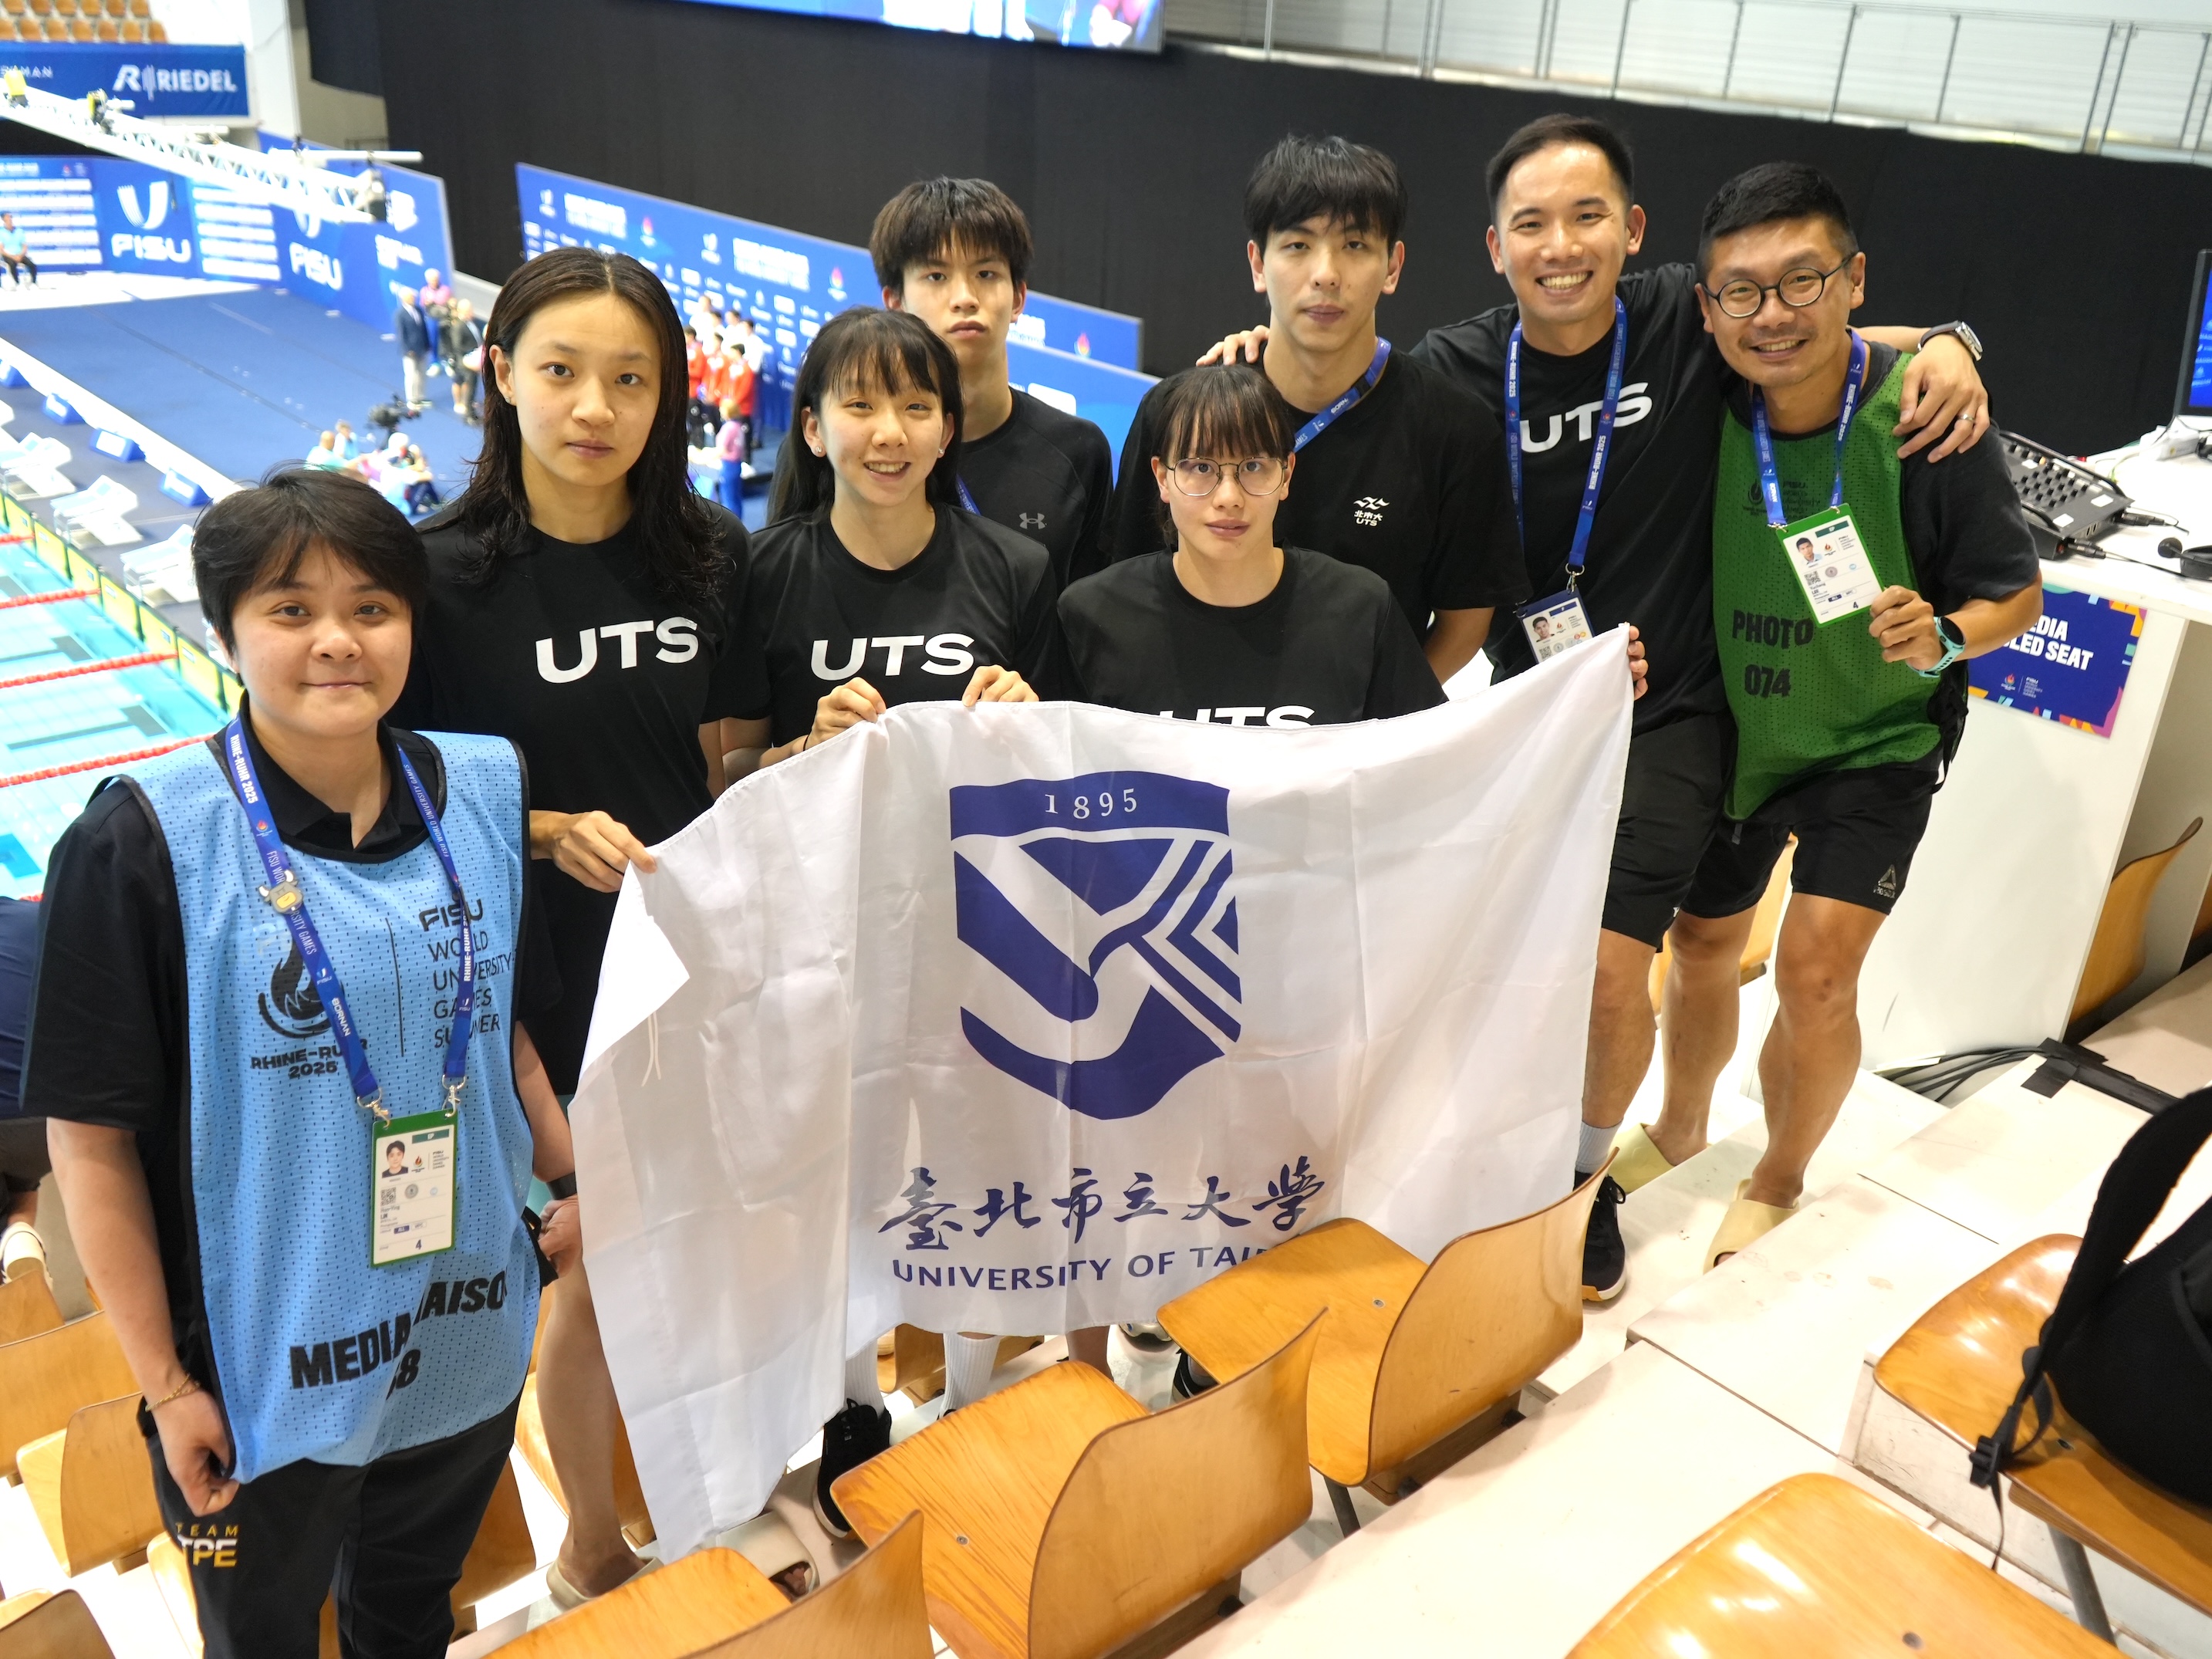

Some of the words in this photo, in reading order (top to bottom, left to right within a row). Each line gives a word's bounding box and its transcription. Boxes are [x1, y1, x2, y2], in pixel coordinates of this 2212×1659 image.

[157, 69, 237, 93] RIEDEL
[111, 233, 191, 263] FISU
[289, 242, 342, 290] FISU
[1520, 382, 1653, 453] UTS
[1354, 510, 1383, 521] 北市大
[1356, 518, 1377, 526] UTS
[1732, 609, 1814, 649] PHOTO
[535, 616, 699, 684] UTS
[811, 633, 974, 681] UTS
[2045, 640, 2094, 671] SEAT
[1744, 664, 1791, 699] 074
[230, 734, 251, 782] RHINE-RUHR
[241, 780, 258, 804] 2025
[404, 764, 417, 784] GAMES
[414, 785, 434, 819] UNIVERSITY
[1045, 788, 1138, 819] 1895
[429, 820, 444, 842] WORLD
[439, 843, 449, 857] FISU
[267, 850, 277, 867] FISU
[299, 931, 317, 956] GAMES
[419, 899, 483, 931] FISU
[427, 931, 488, 962] WOLD
[433, 952, 512, 991] UNERSITY
[332, 998, 351, 1036] BORNAN
[250, 1039, 368, 1069] RHINE-RUR
[288, 1060, 338, 1080] 2025
[415, 1238, 422, 1250] 4
[893, 1259, 1111, 1291] UNIVERSITY
[1128, 1251, 1176, 1278] OF
[1190, 1246, 1298, 1269] TAI
[289, 1312, 411, 1389] MEDIA
[176, 1522, 240, 1537] TEAM
[177, 1535, 238, 1568] TPE
